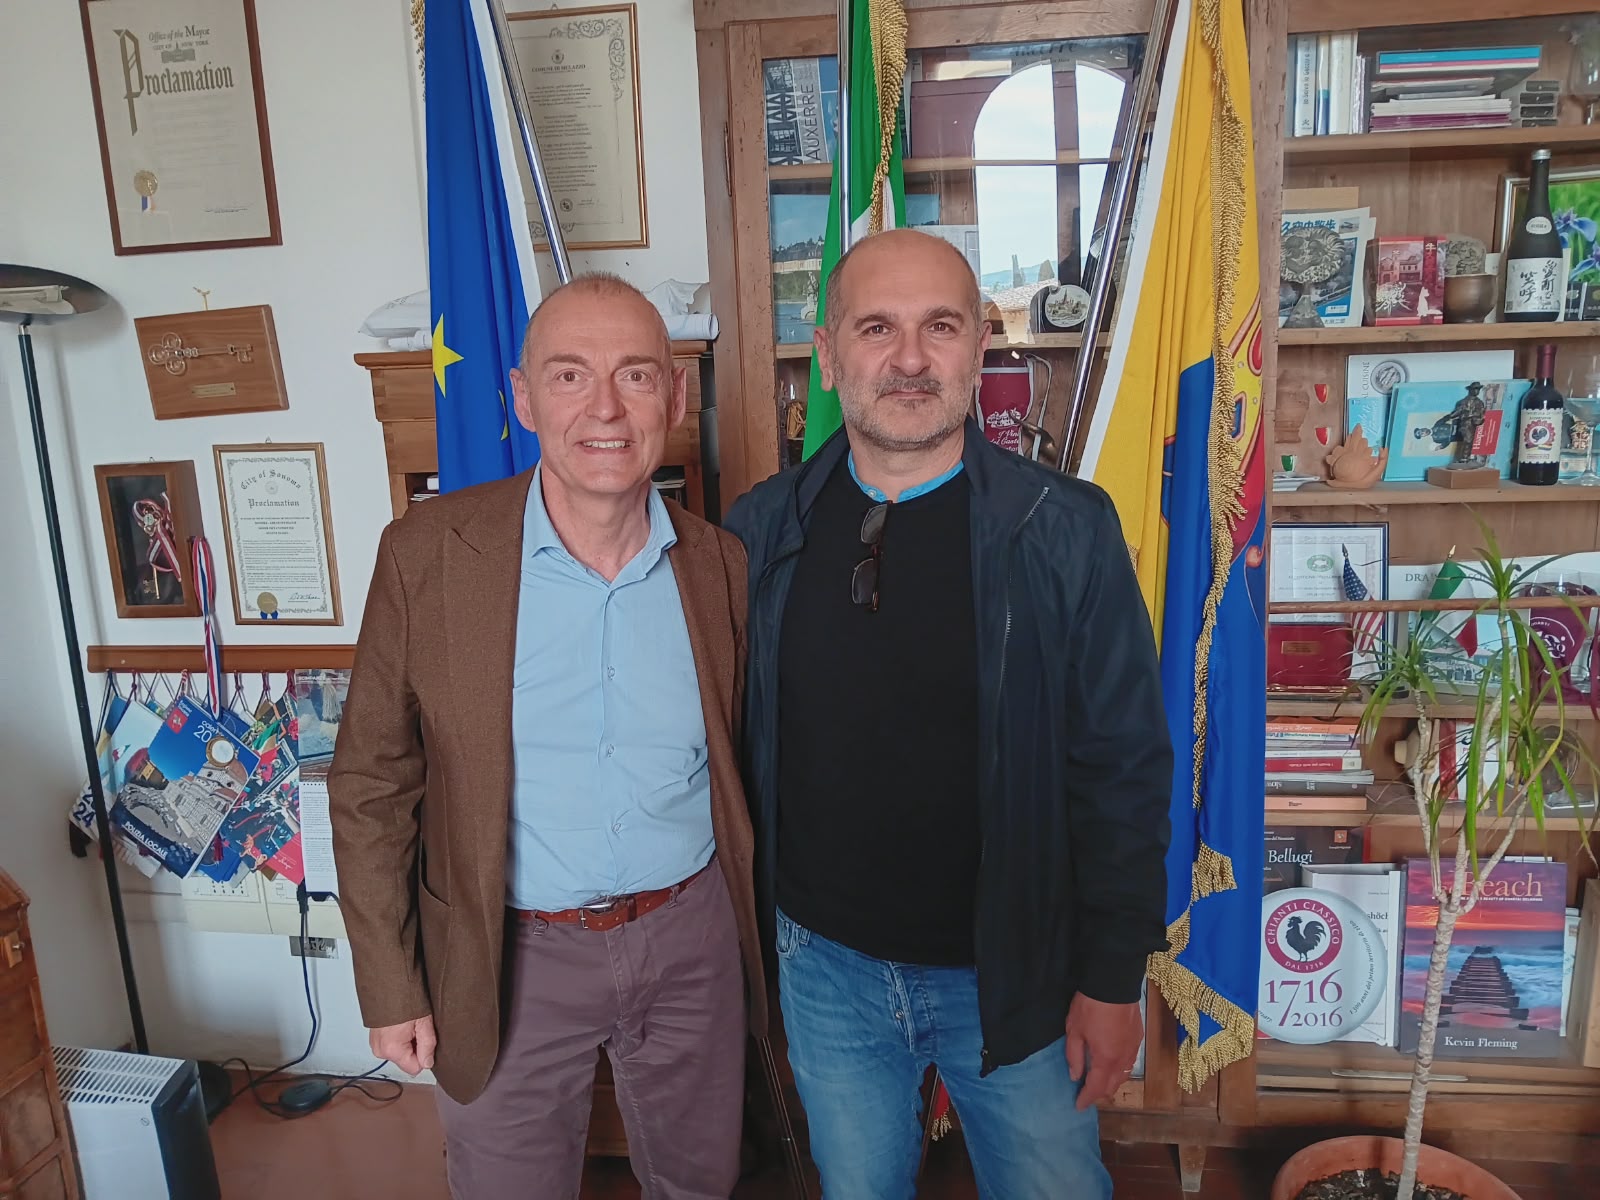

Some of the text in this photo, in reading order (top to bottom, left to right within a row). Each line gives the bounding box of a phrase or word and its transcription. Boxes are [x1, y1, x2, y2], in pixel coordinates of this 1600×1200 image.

[184, 25, 210, 38] Mayor
[112, 29, 234, 136] Proclamation
[800, 84, 822, 161] AUXERRE
[248, 498, 300, 509] Proclamation
[193, 725, 212, 742] 20
[73, 804, 96, 828] 24
[124, 821, 169, 857] POLIZIA LOCALE
[1268, 848, 1313, 866] Bellugi
[1460, 871, 1543, 897] Beach
[1267, 901, 1340, 944] CHIANTI CLASSICO
[1285, 961, 1301, 970] DAL
[1264, 968, 1343, 1026] 1716
[1291, 1006, 1343, 1027] 2016
[1444, 1036, 1518, 1050] Kevin Fleming
